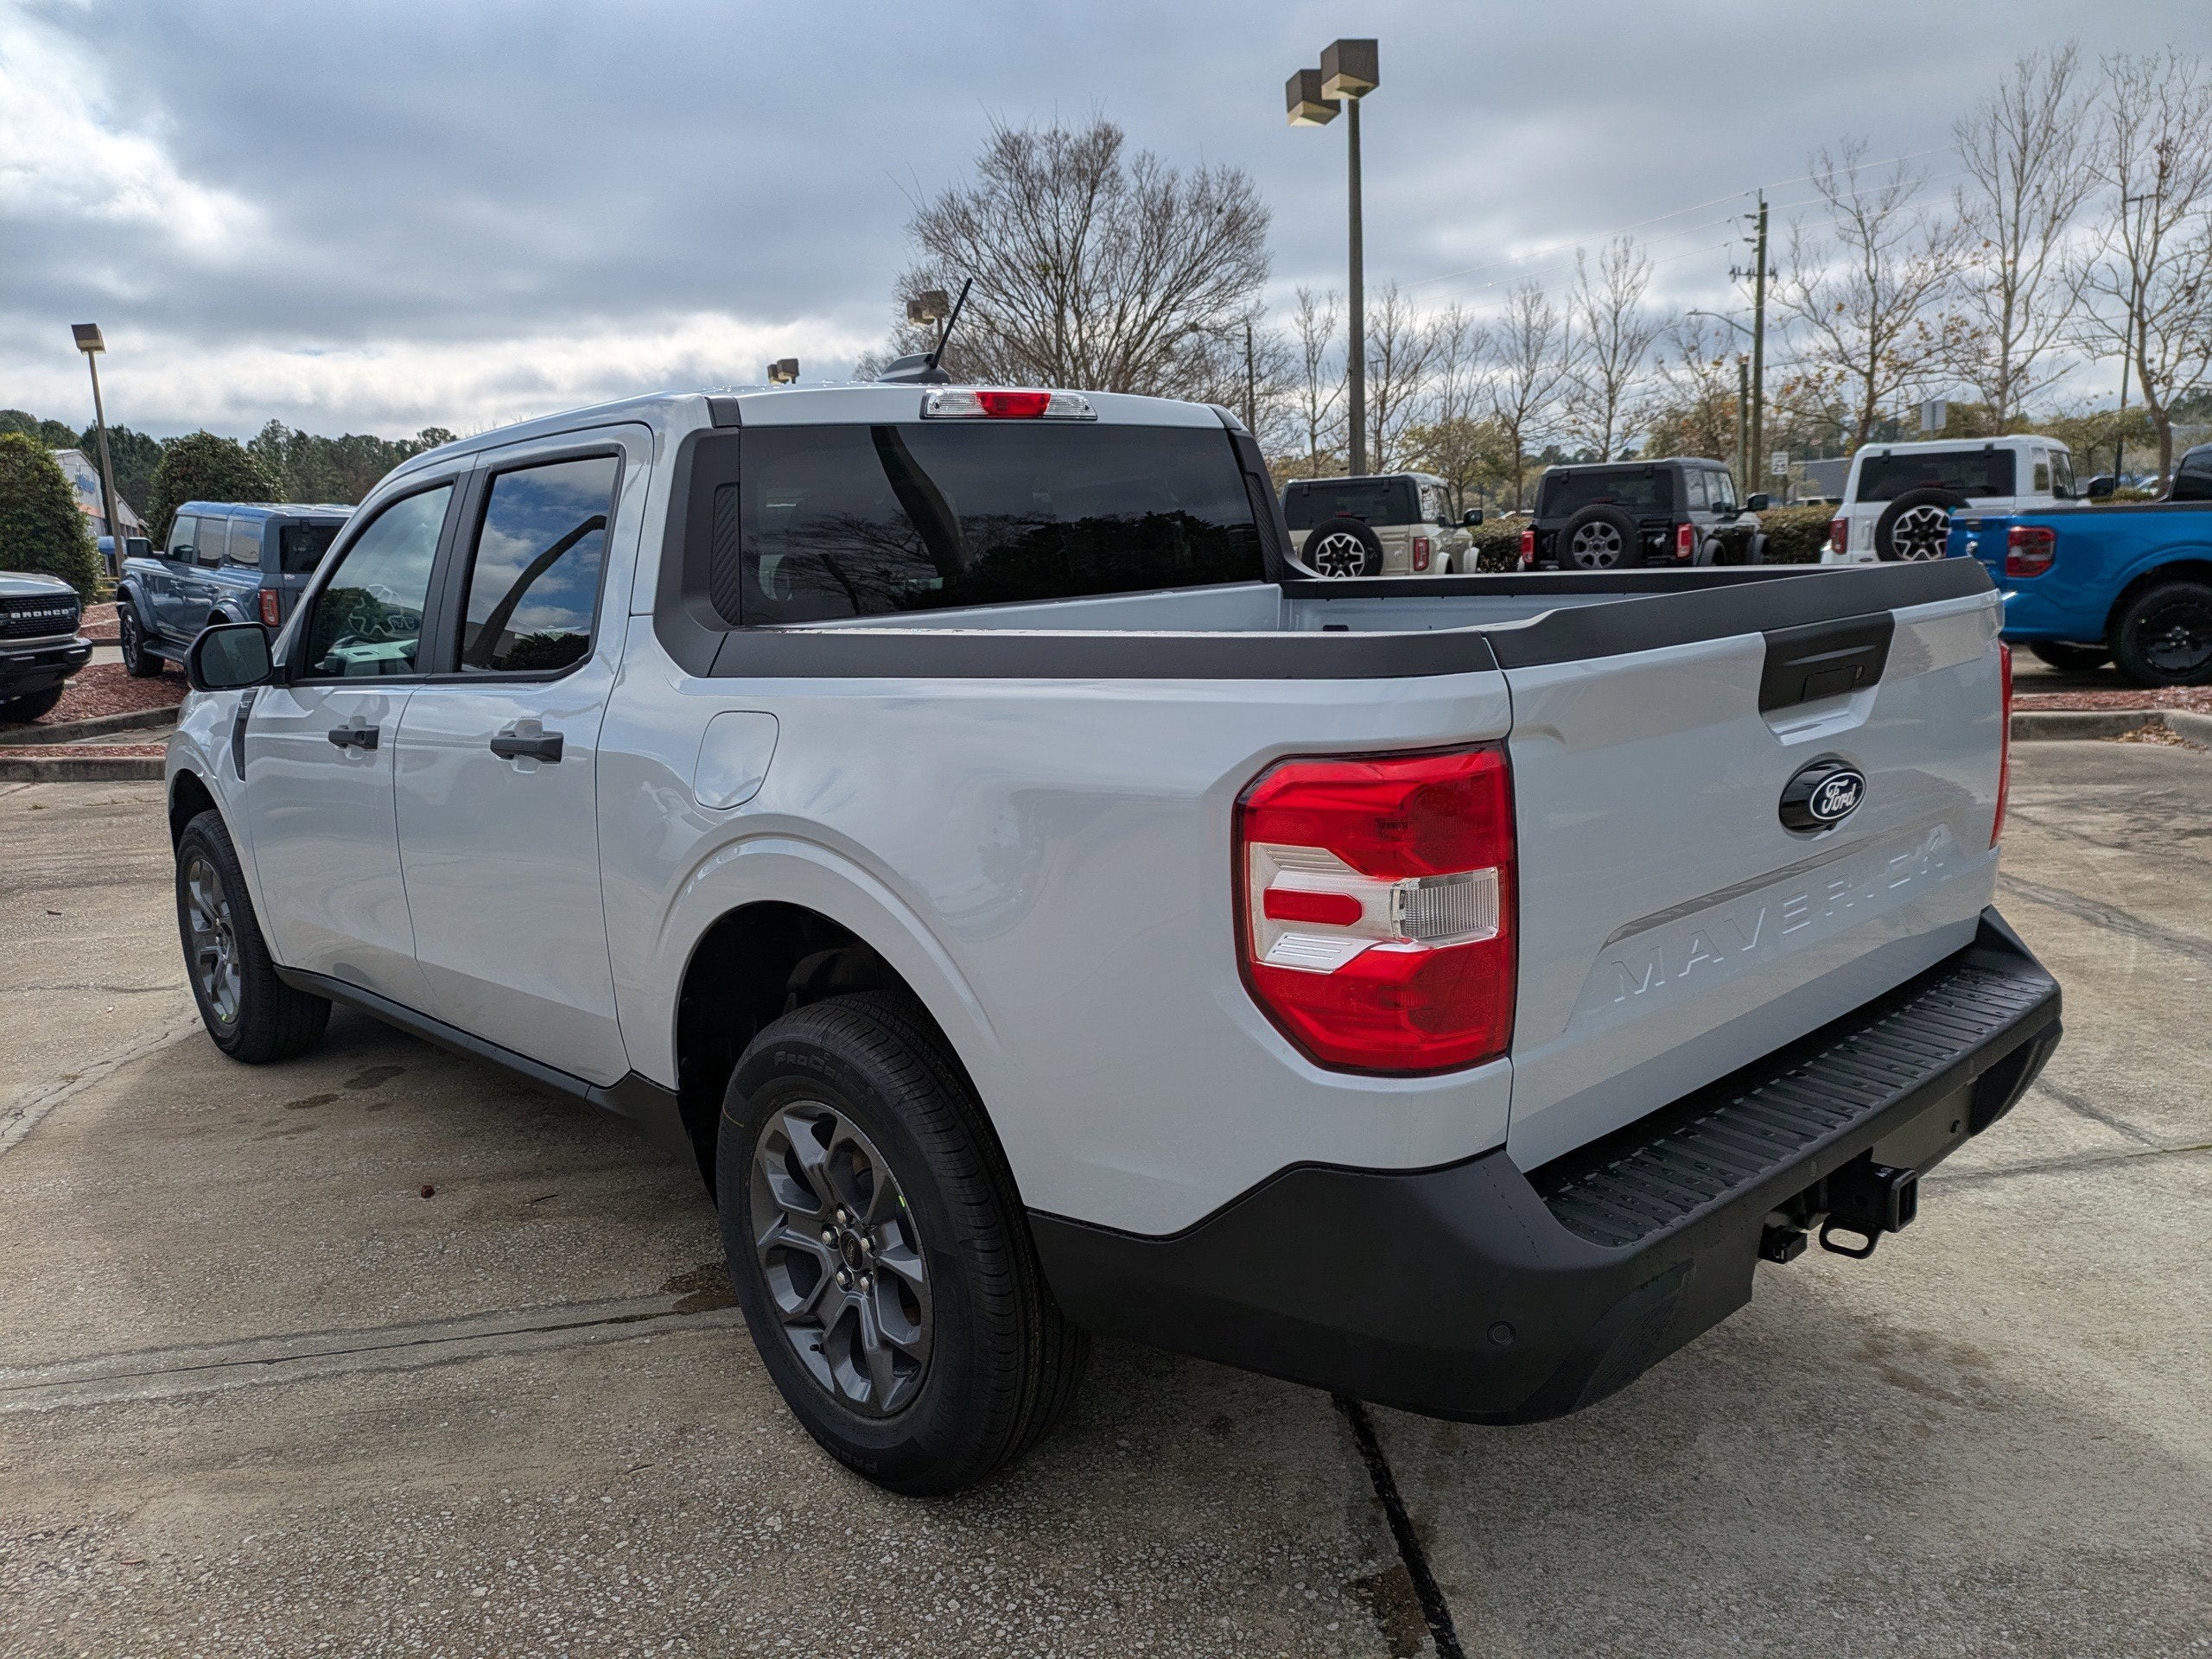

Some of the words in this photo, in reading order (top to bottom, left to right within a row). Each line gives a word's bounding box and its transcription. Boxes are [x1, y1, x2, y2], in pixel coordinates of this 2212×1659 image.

[10, 608, 69, 619] BRONCO
[1821, 779, 1857, 814] Ford
[1611, 827, 1947, 1003] MAVERICK
